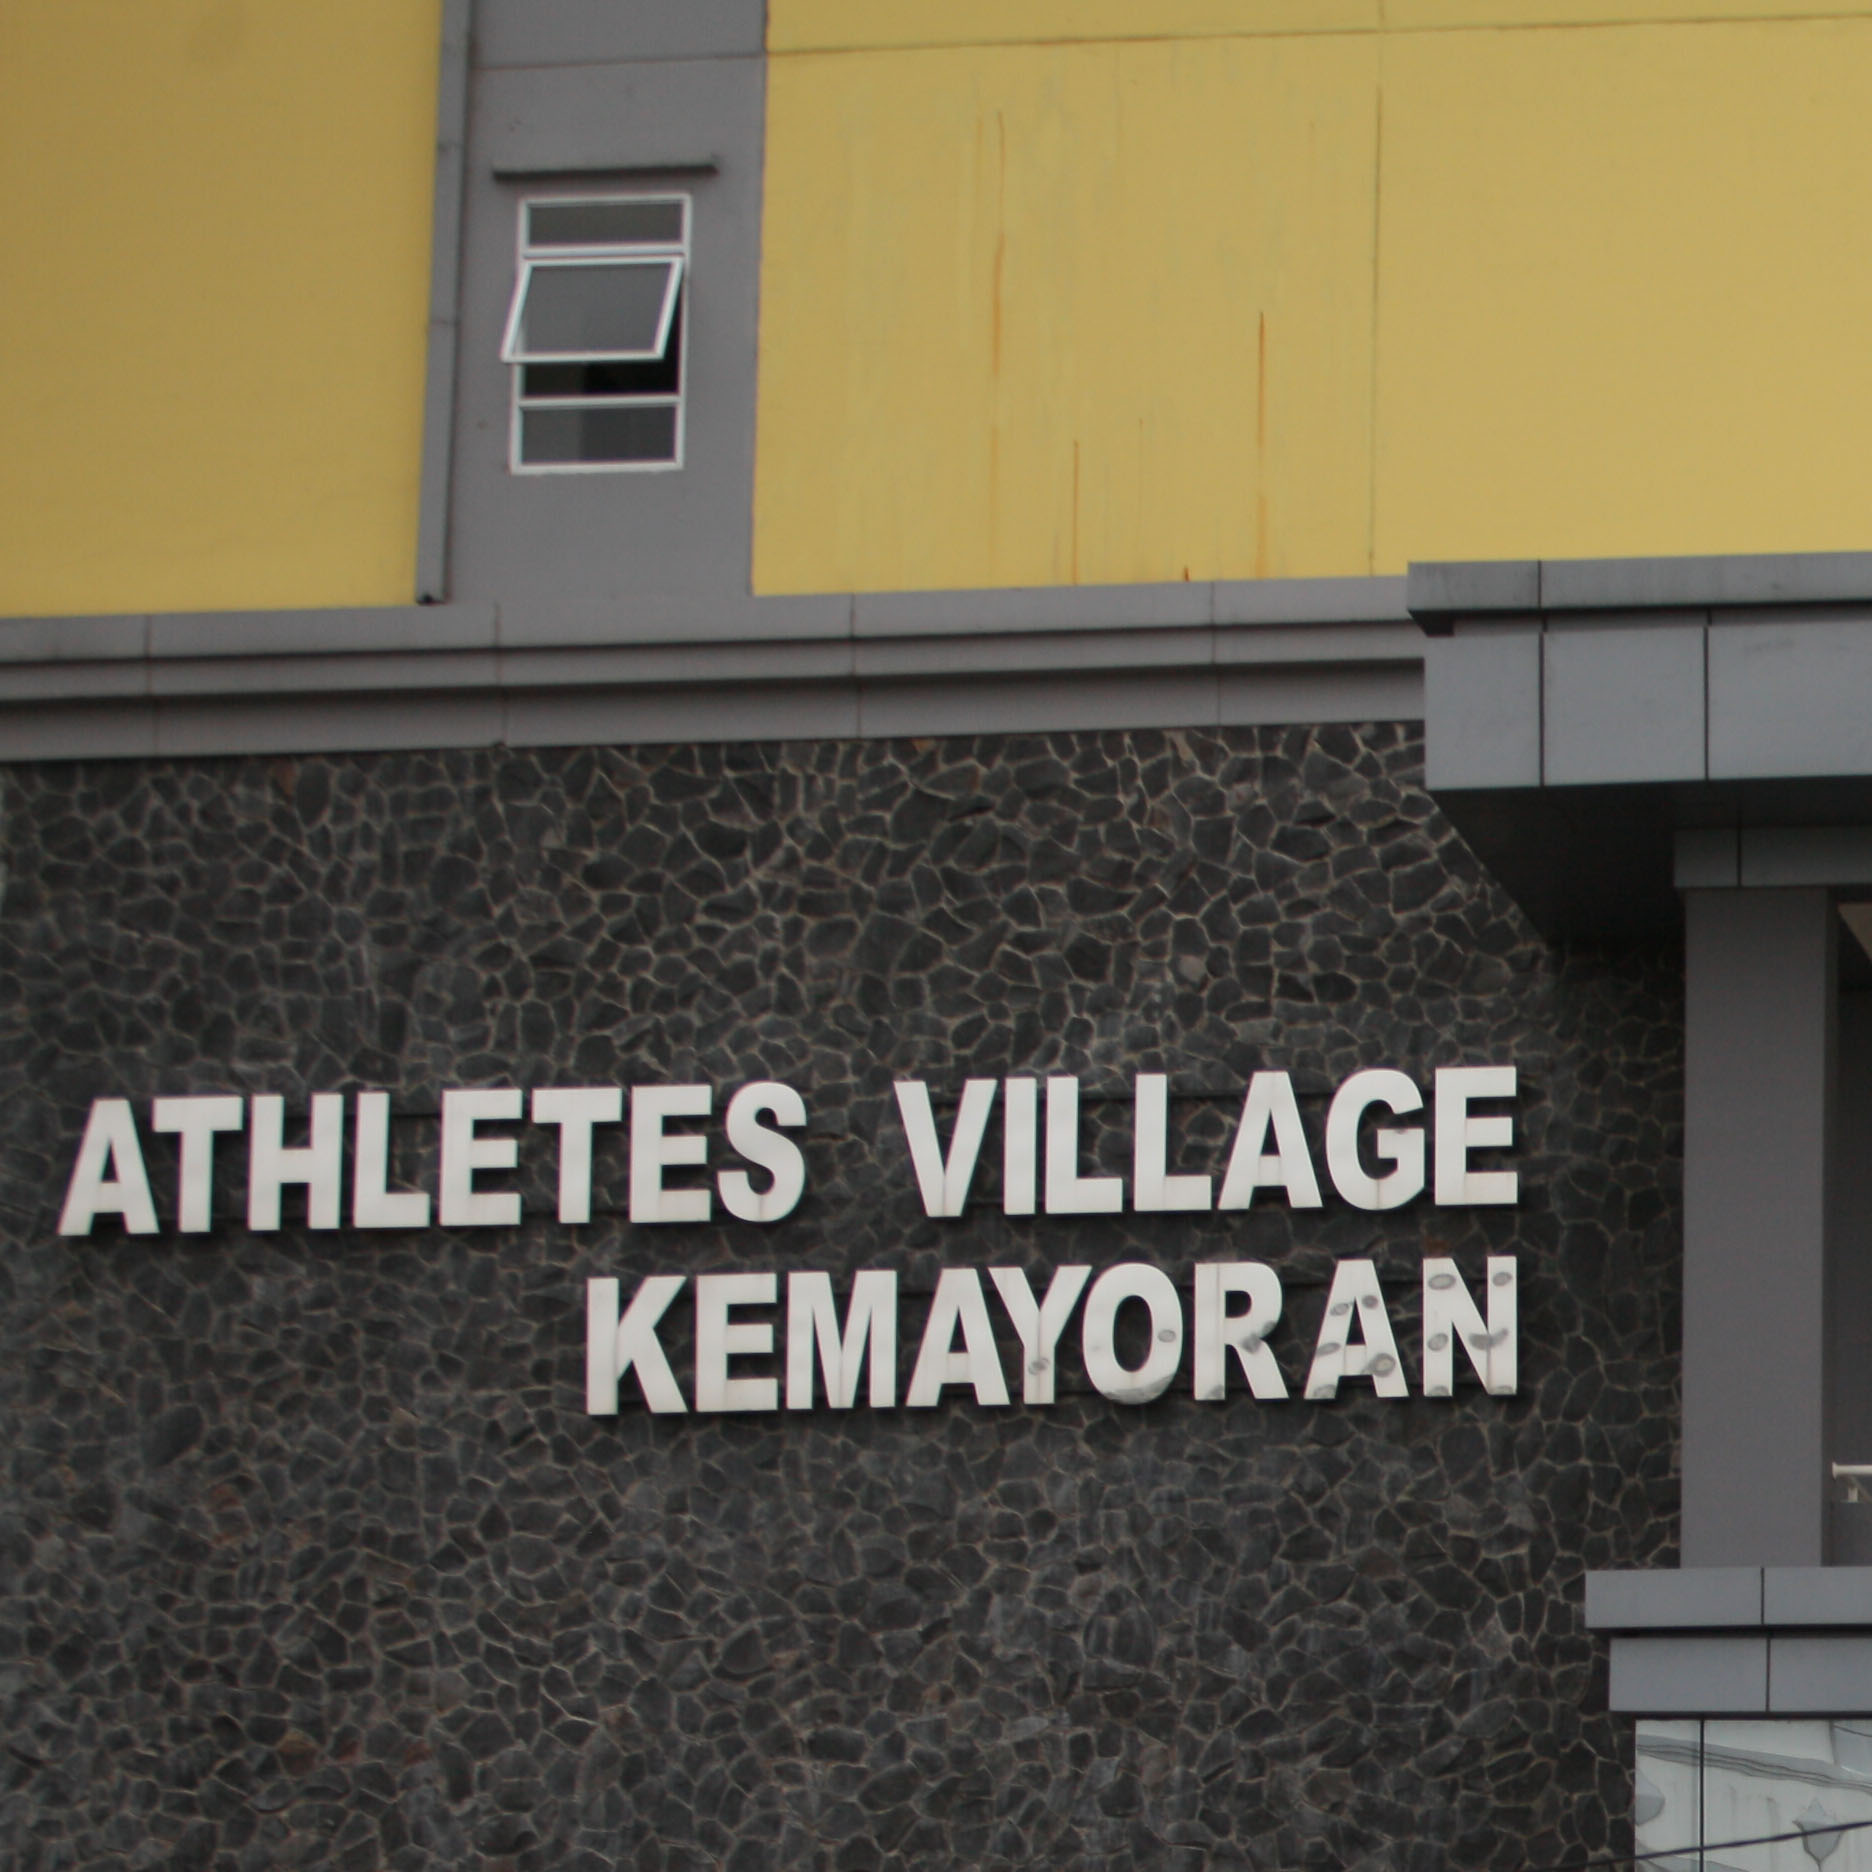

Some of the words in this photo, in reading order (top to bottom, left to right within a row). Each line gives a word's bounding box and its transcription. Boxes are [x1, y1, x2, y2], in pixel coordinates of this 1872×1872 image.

[59, 1080, 808, 1237] ATHLETES
[893, 1065, 1519, 1219] VILLAGE
[586, 1255, 1518, 1417] KEMAYORAN
